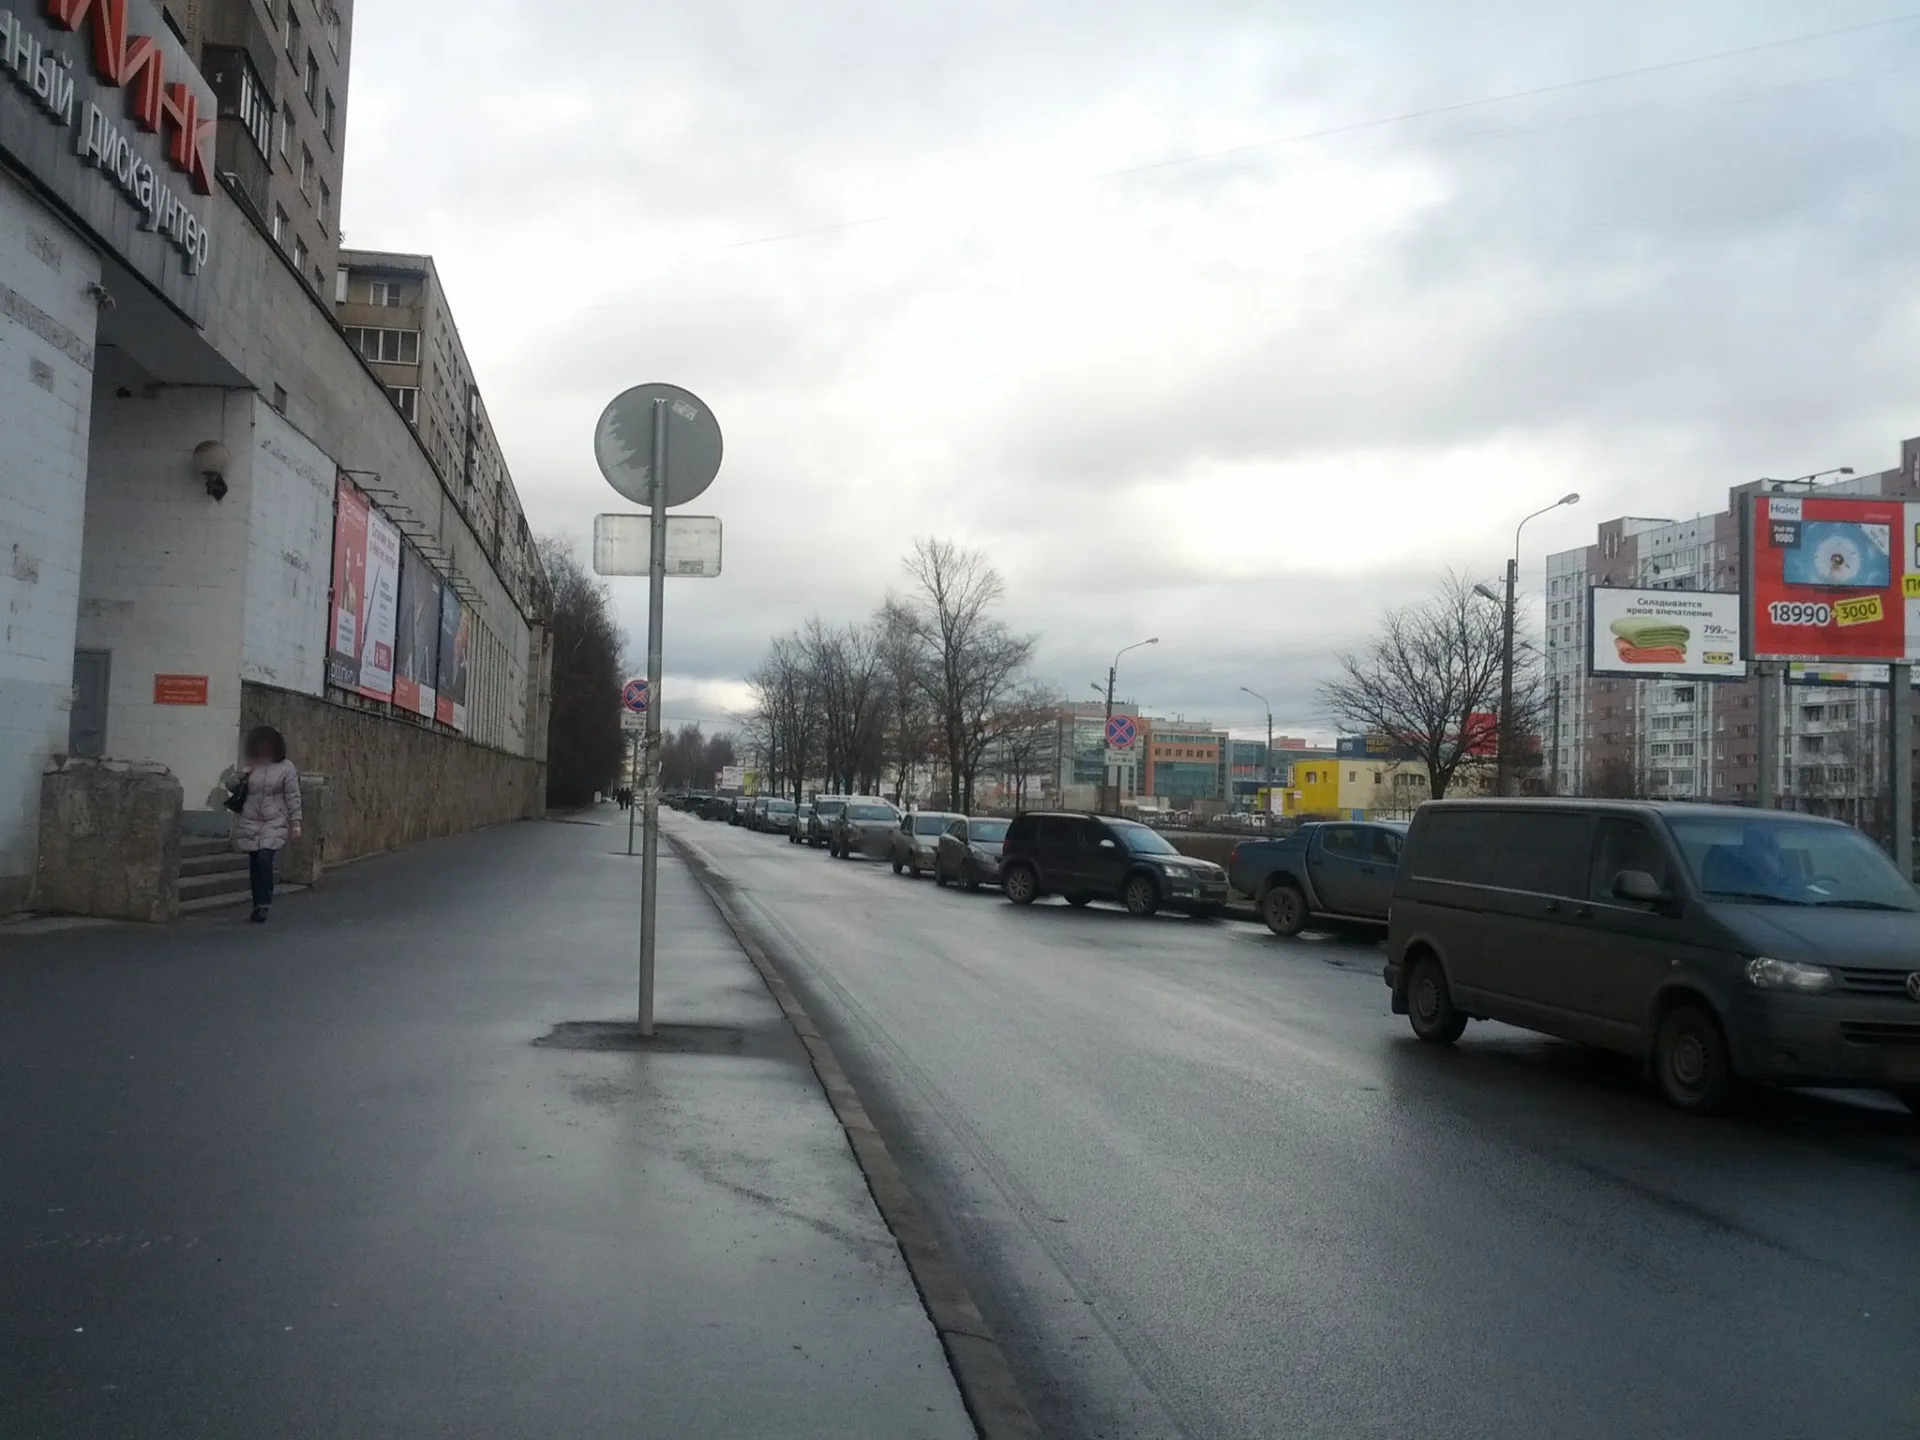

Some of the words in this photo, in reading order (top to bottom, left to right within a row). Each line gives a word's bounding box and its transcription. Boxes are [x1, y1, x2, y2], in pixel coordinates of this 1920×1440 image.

[82, 101, 208, 276] дискаунтер
[1770, 503, 1800, 515] Haier
[1637, 597, 1702, 608] Складывается
[1626, 607, 1654, 616] яркое
[1655, 609, 1713, 618] впечатление
[1770, 604, 1829, 623] 18990
[1841, 602, 1878, 619] 3000
